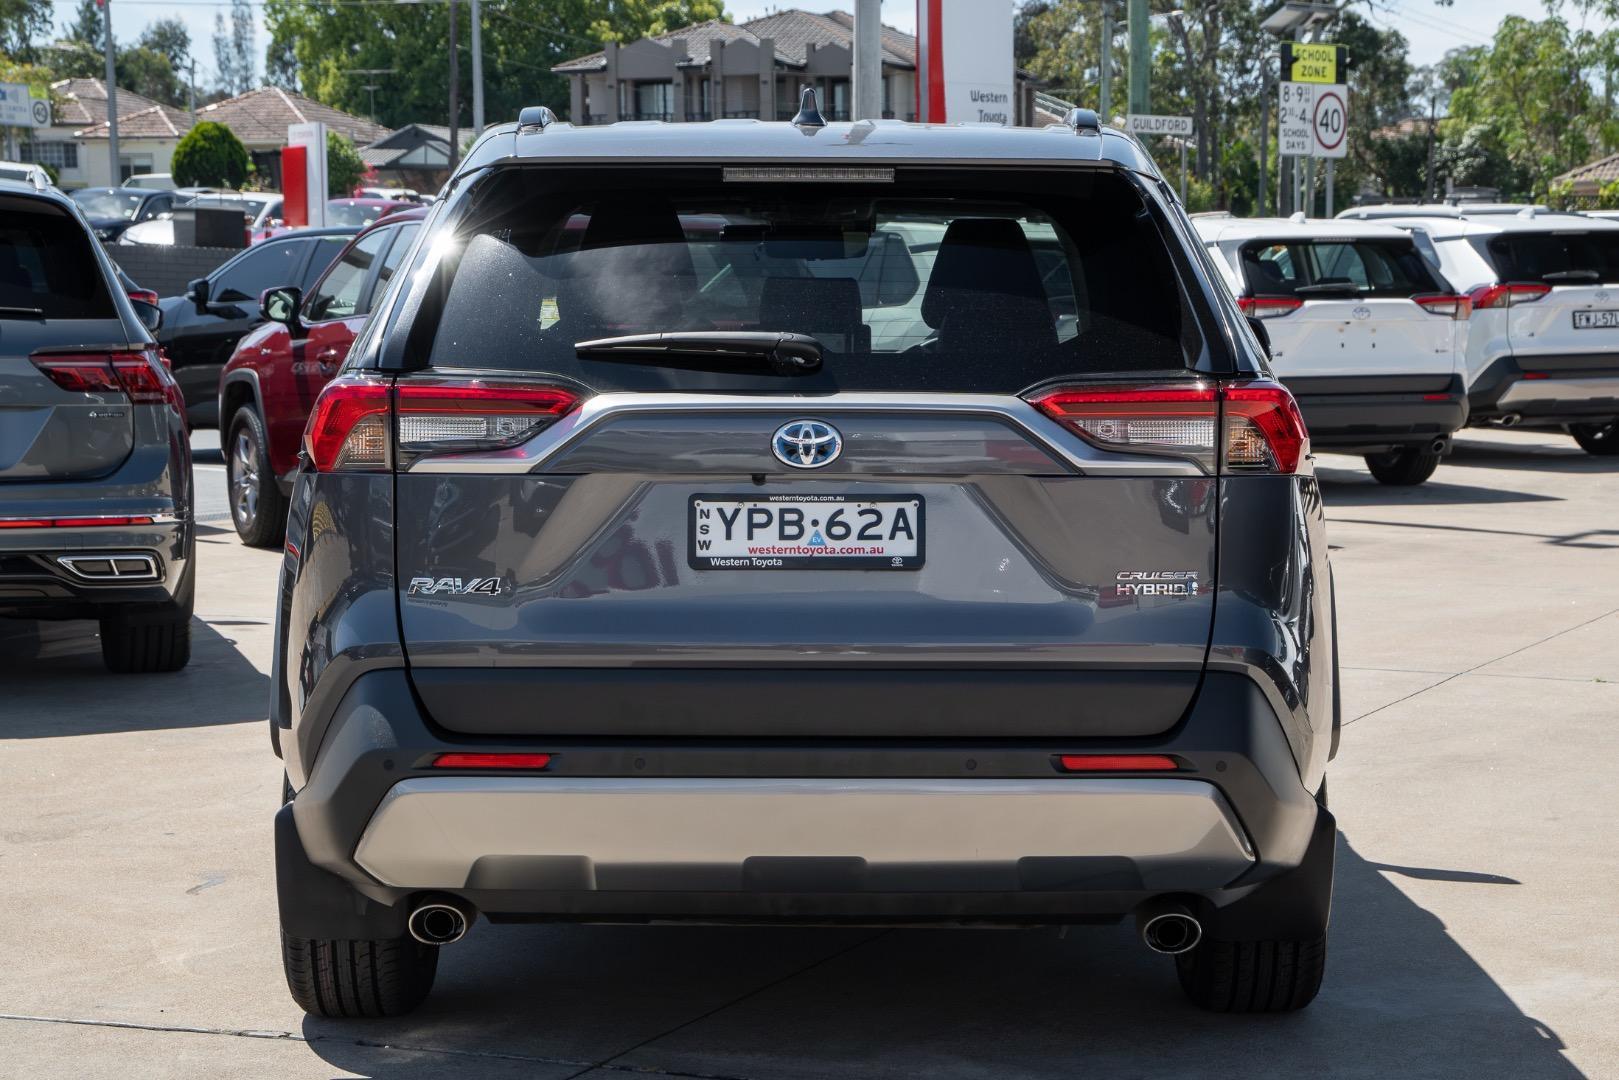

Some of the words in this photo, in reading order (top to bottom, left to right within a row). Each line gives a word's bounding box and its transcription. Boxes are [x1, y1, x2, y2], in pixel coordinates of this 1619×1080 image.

[1295, 49, 1333, 62] SCHOOL
[1301, 65, 1327, 78] ZONE
[970, 90, 1008, 103] Western
[977, 109, 1007, 124] Toyota
[1319, 108, 1341, 133] 40
[1133, 117, 1188, 131] GUILDFORD
[1283, 128, 1309, 138] SCHOOL
[1286, 140, 1306, 150] DAYS
[748, 545, 884, 557] westerntoyota.com.au
[710, 557, 749, 566] Western
[752, 557, 783, 568] Toyota
[1116, 571, 1199, 580] CRUISER
[407, 577, 502, 595] RAV4
[1116, 583, 1188, 596] HYBRID
